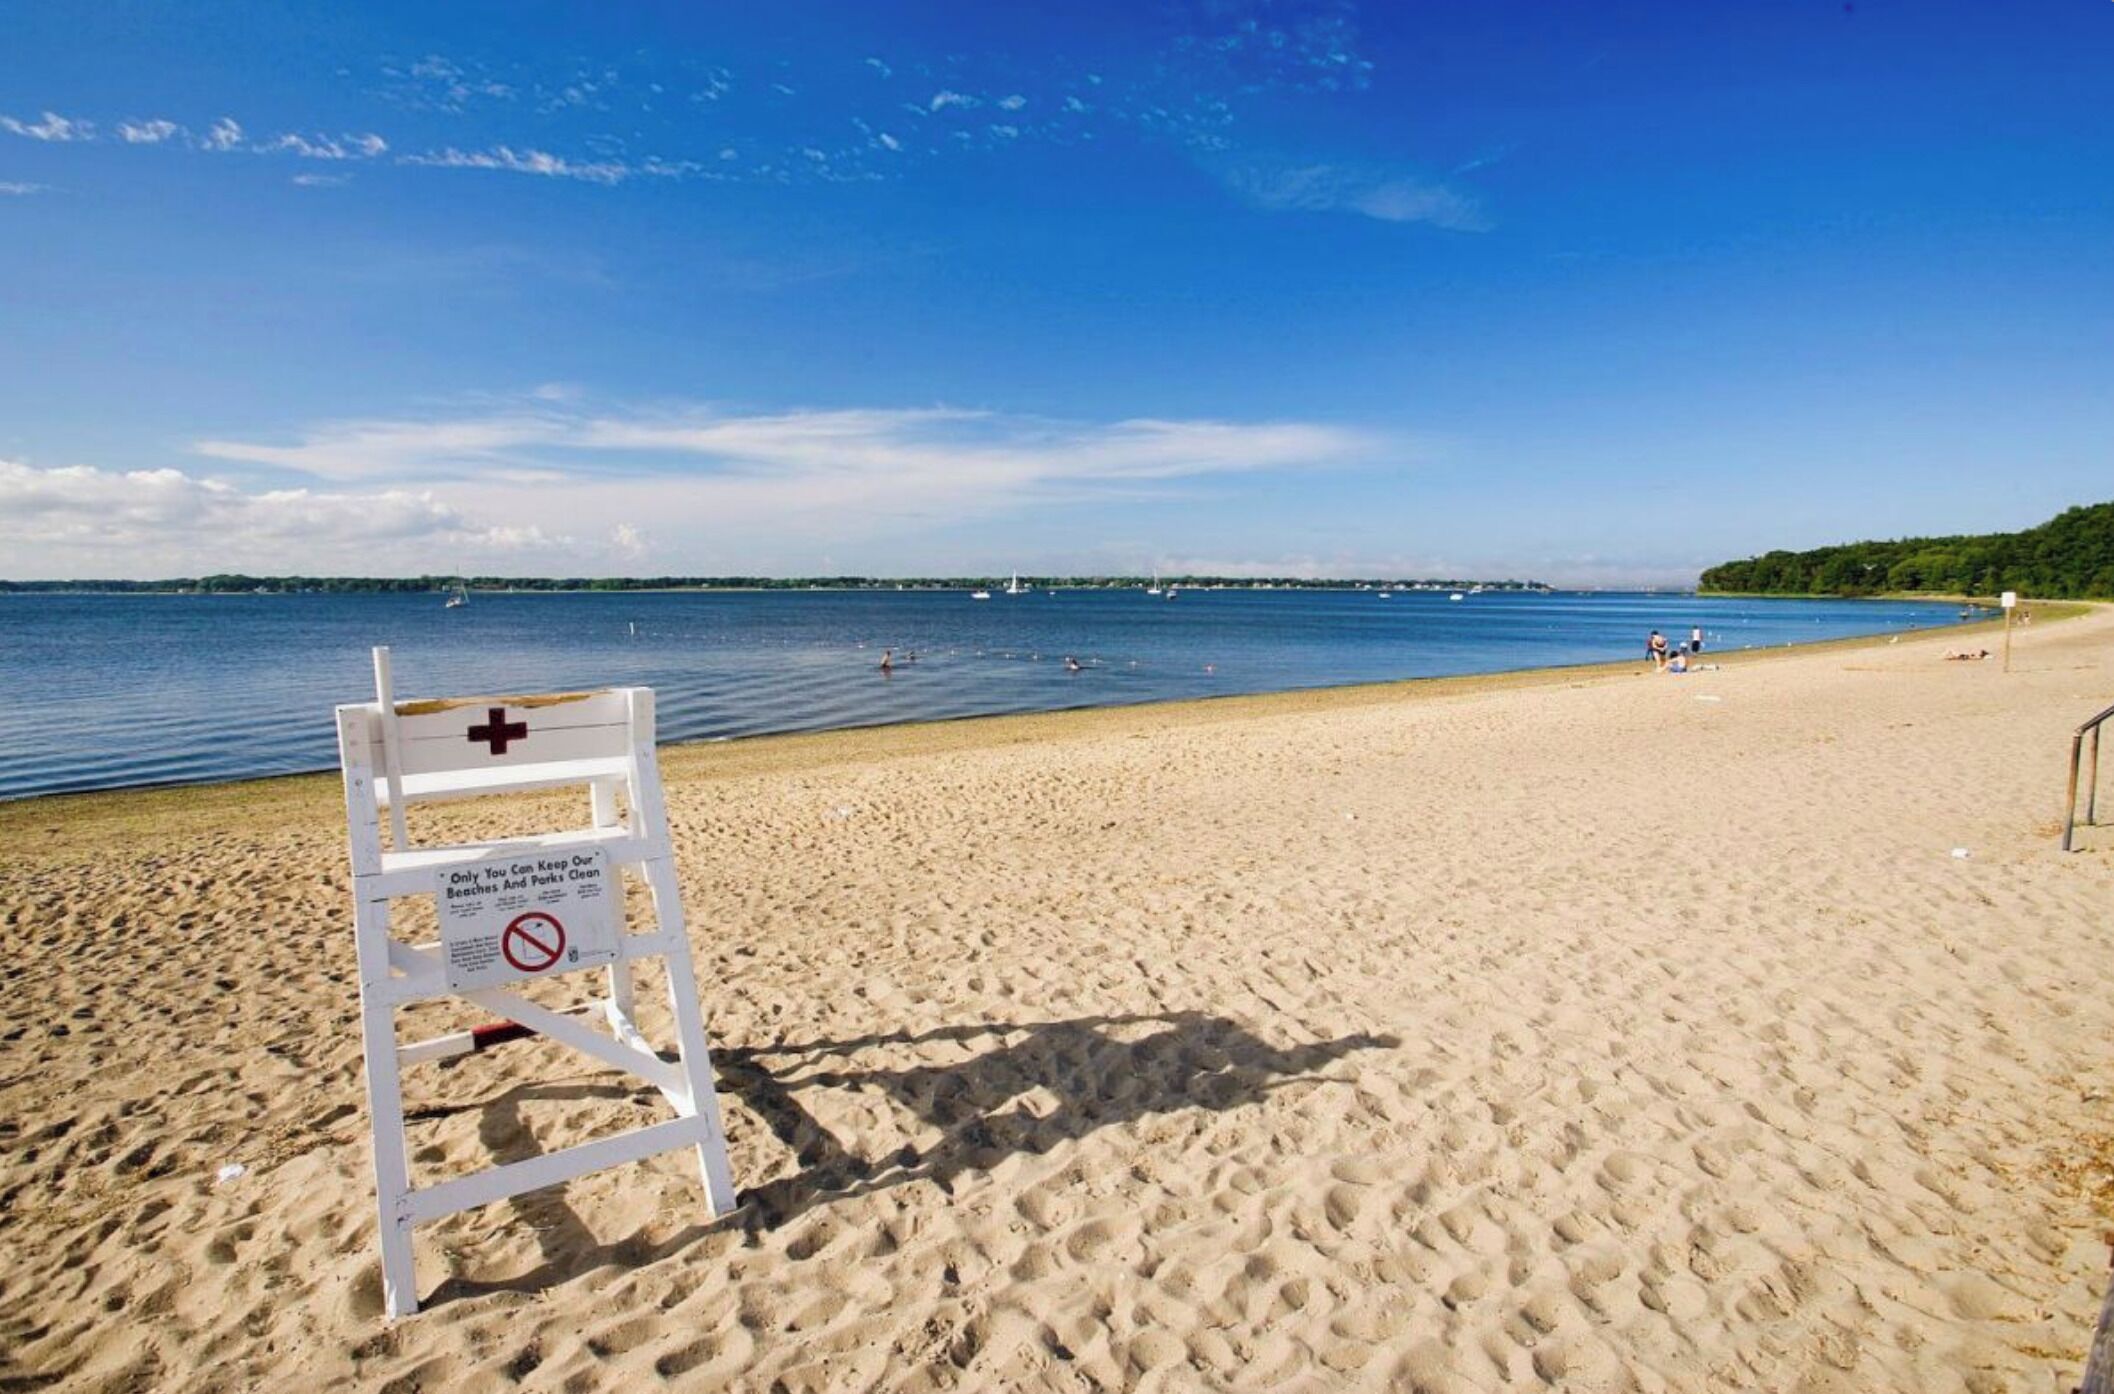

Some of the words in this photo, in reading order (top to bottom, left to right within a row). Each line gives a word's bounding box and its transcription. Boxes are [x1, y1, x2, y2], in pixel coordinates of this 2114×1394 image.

[447, 884, 498, 898] Beaches
[503, 878, 527, 890] And
[531, 873, 564, 887] Parks
[568, 868, 600, 881] Clean
[451, 872, 479, 886] Only
[485, 867, 507, 879] You
[511, 863, 534, 875] Can
[538, 859, 568, 873] Keep
[572, 855, 593, 867] Our
